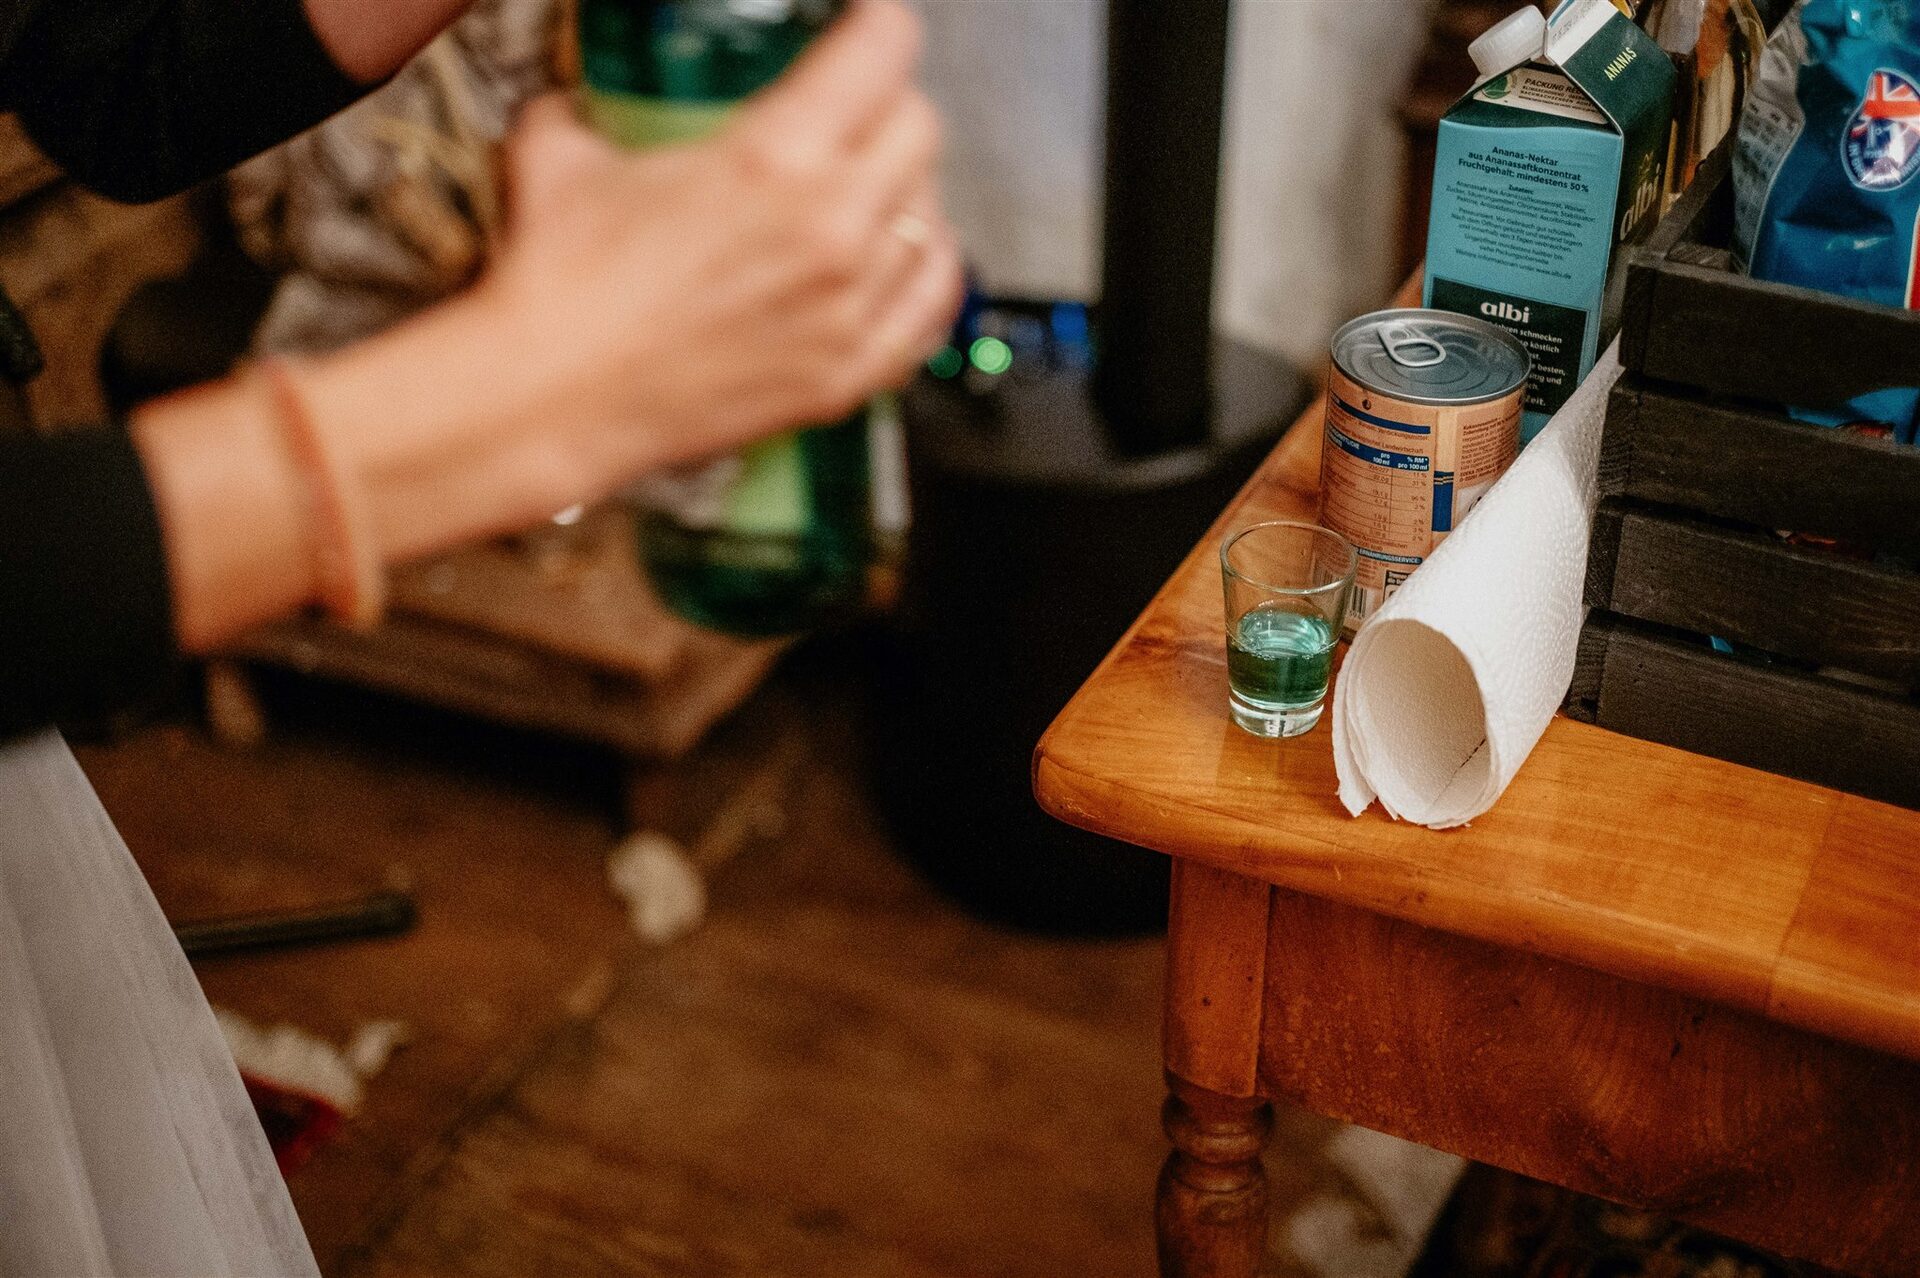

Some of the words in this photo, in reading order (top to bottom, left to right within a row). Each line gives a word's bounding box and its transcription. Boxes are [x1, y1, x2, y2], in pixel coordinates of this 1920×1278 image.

[1603, 46, 1637, 81] ANANAS
[1524, 78, 1564, 93] PACKUNG
[1468, 151, 1483, 161] aus
[1485, 154, 1581, 182] Ananassaftkonzentrat
[1492, 146, 1558, 167] Ananas-Nektar
[1458, 158, 1515, 178] Fruchtgehalt:
[1516, 172, 1568, 189] mindestens
[1620, 163, 1660, 240] albi
[1480, 301, 1530, 324] albi
[1520, 329, 1563, 344] schmecken
[1530, 341, 1560, 353] köstlich
[1380, 452, 1391, 460] pro
